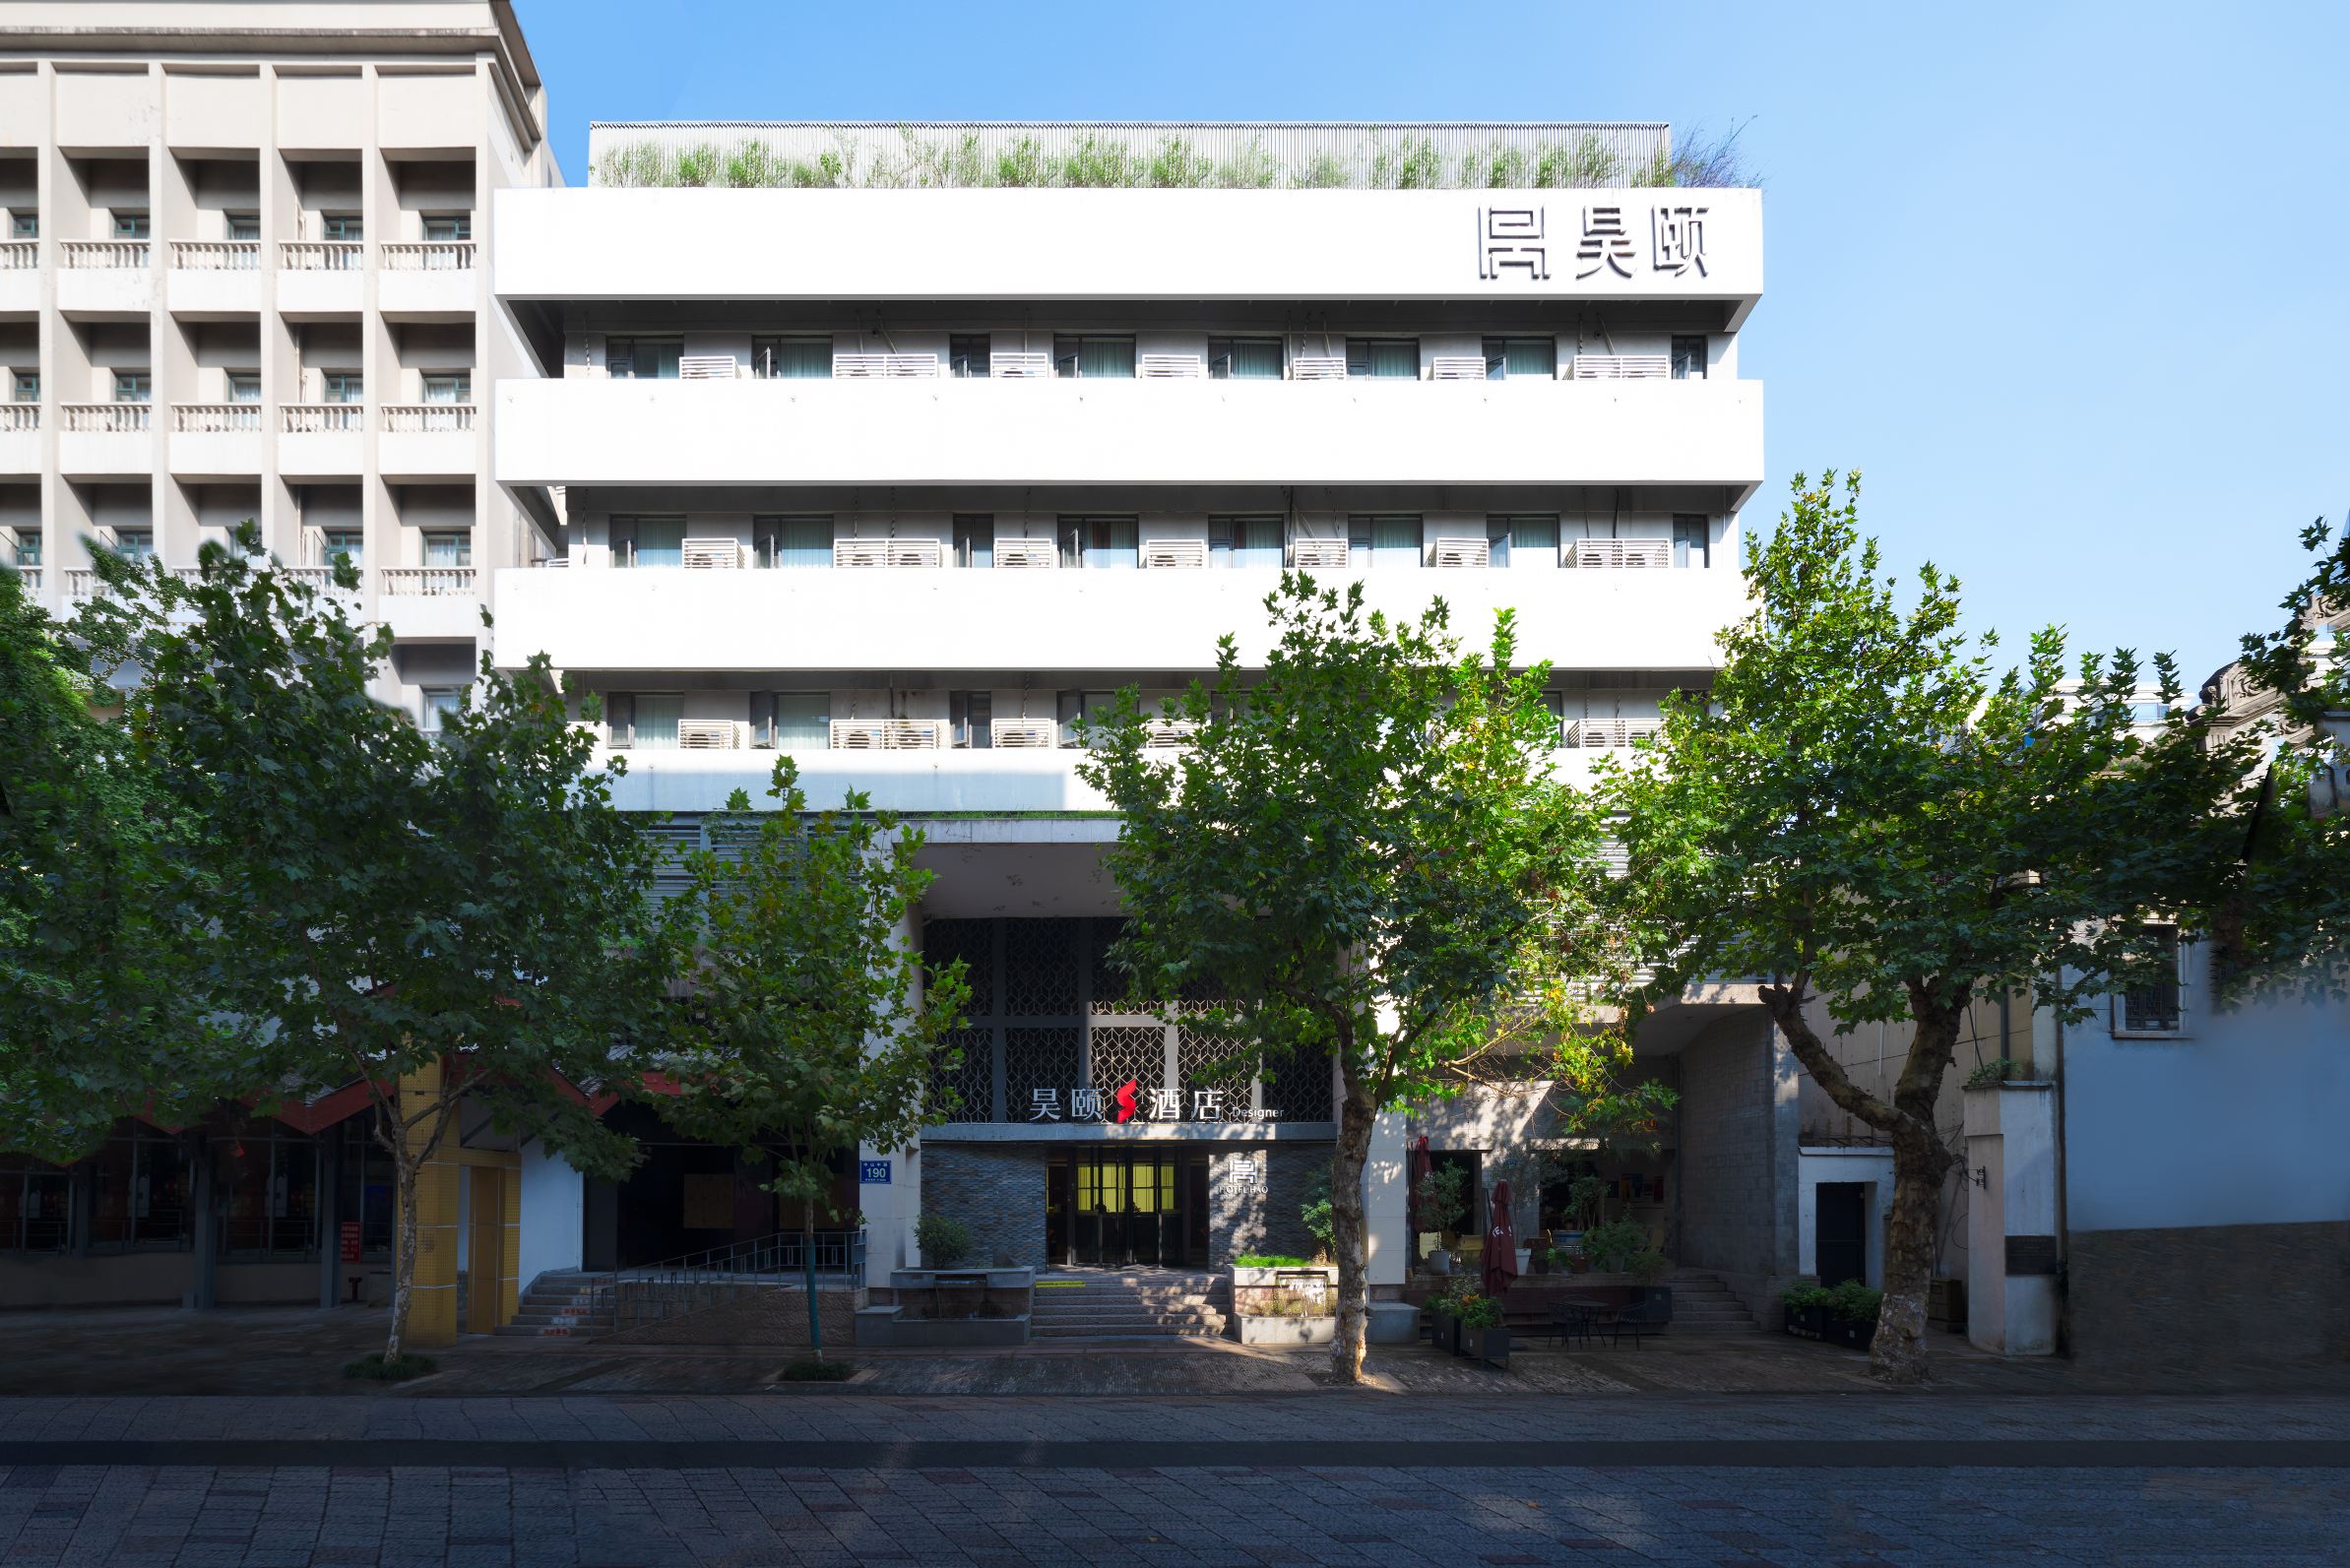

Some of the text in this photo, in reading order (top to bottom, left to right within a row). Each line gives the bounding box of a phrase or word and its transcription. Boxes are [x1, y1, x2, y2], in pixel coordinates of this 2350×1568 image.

[1575, 204, 1710, 280] 昊颐
[1232, 1106, 1284, 1120] Designer
[866, 1167, 886, 1179] 190
[1219, 1185, 1269, 1195] HOTEL HAO
